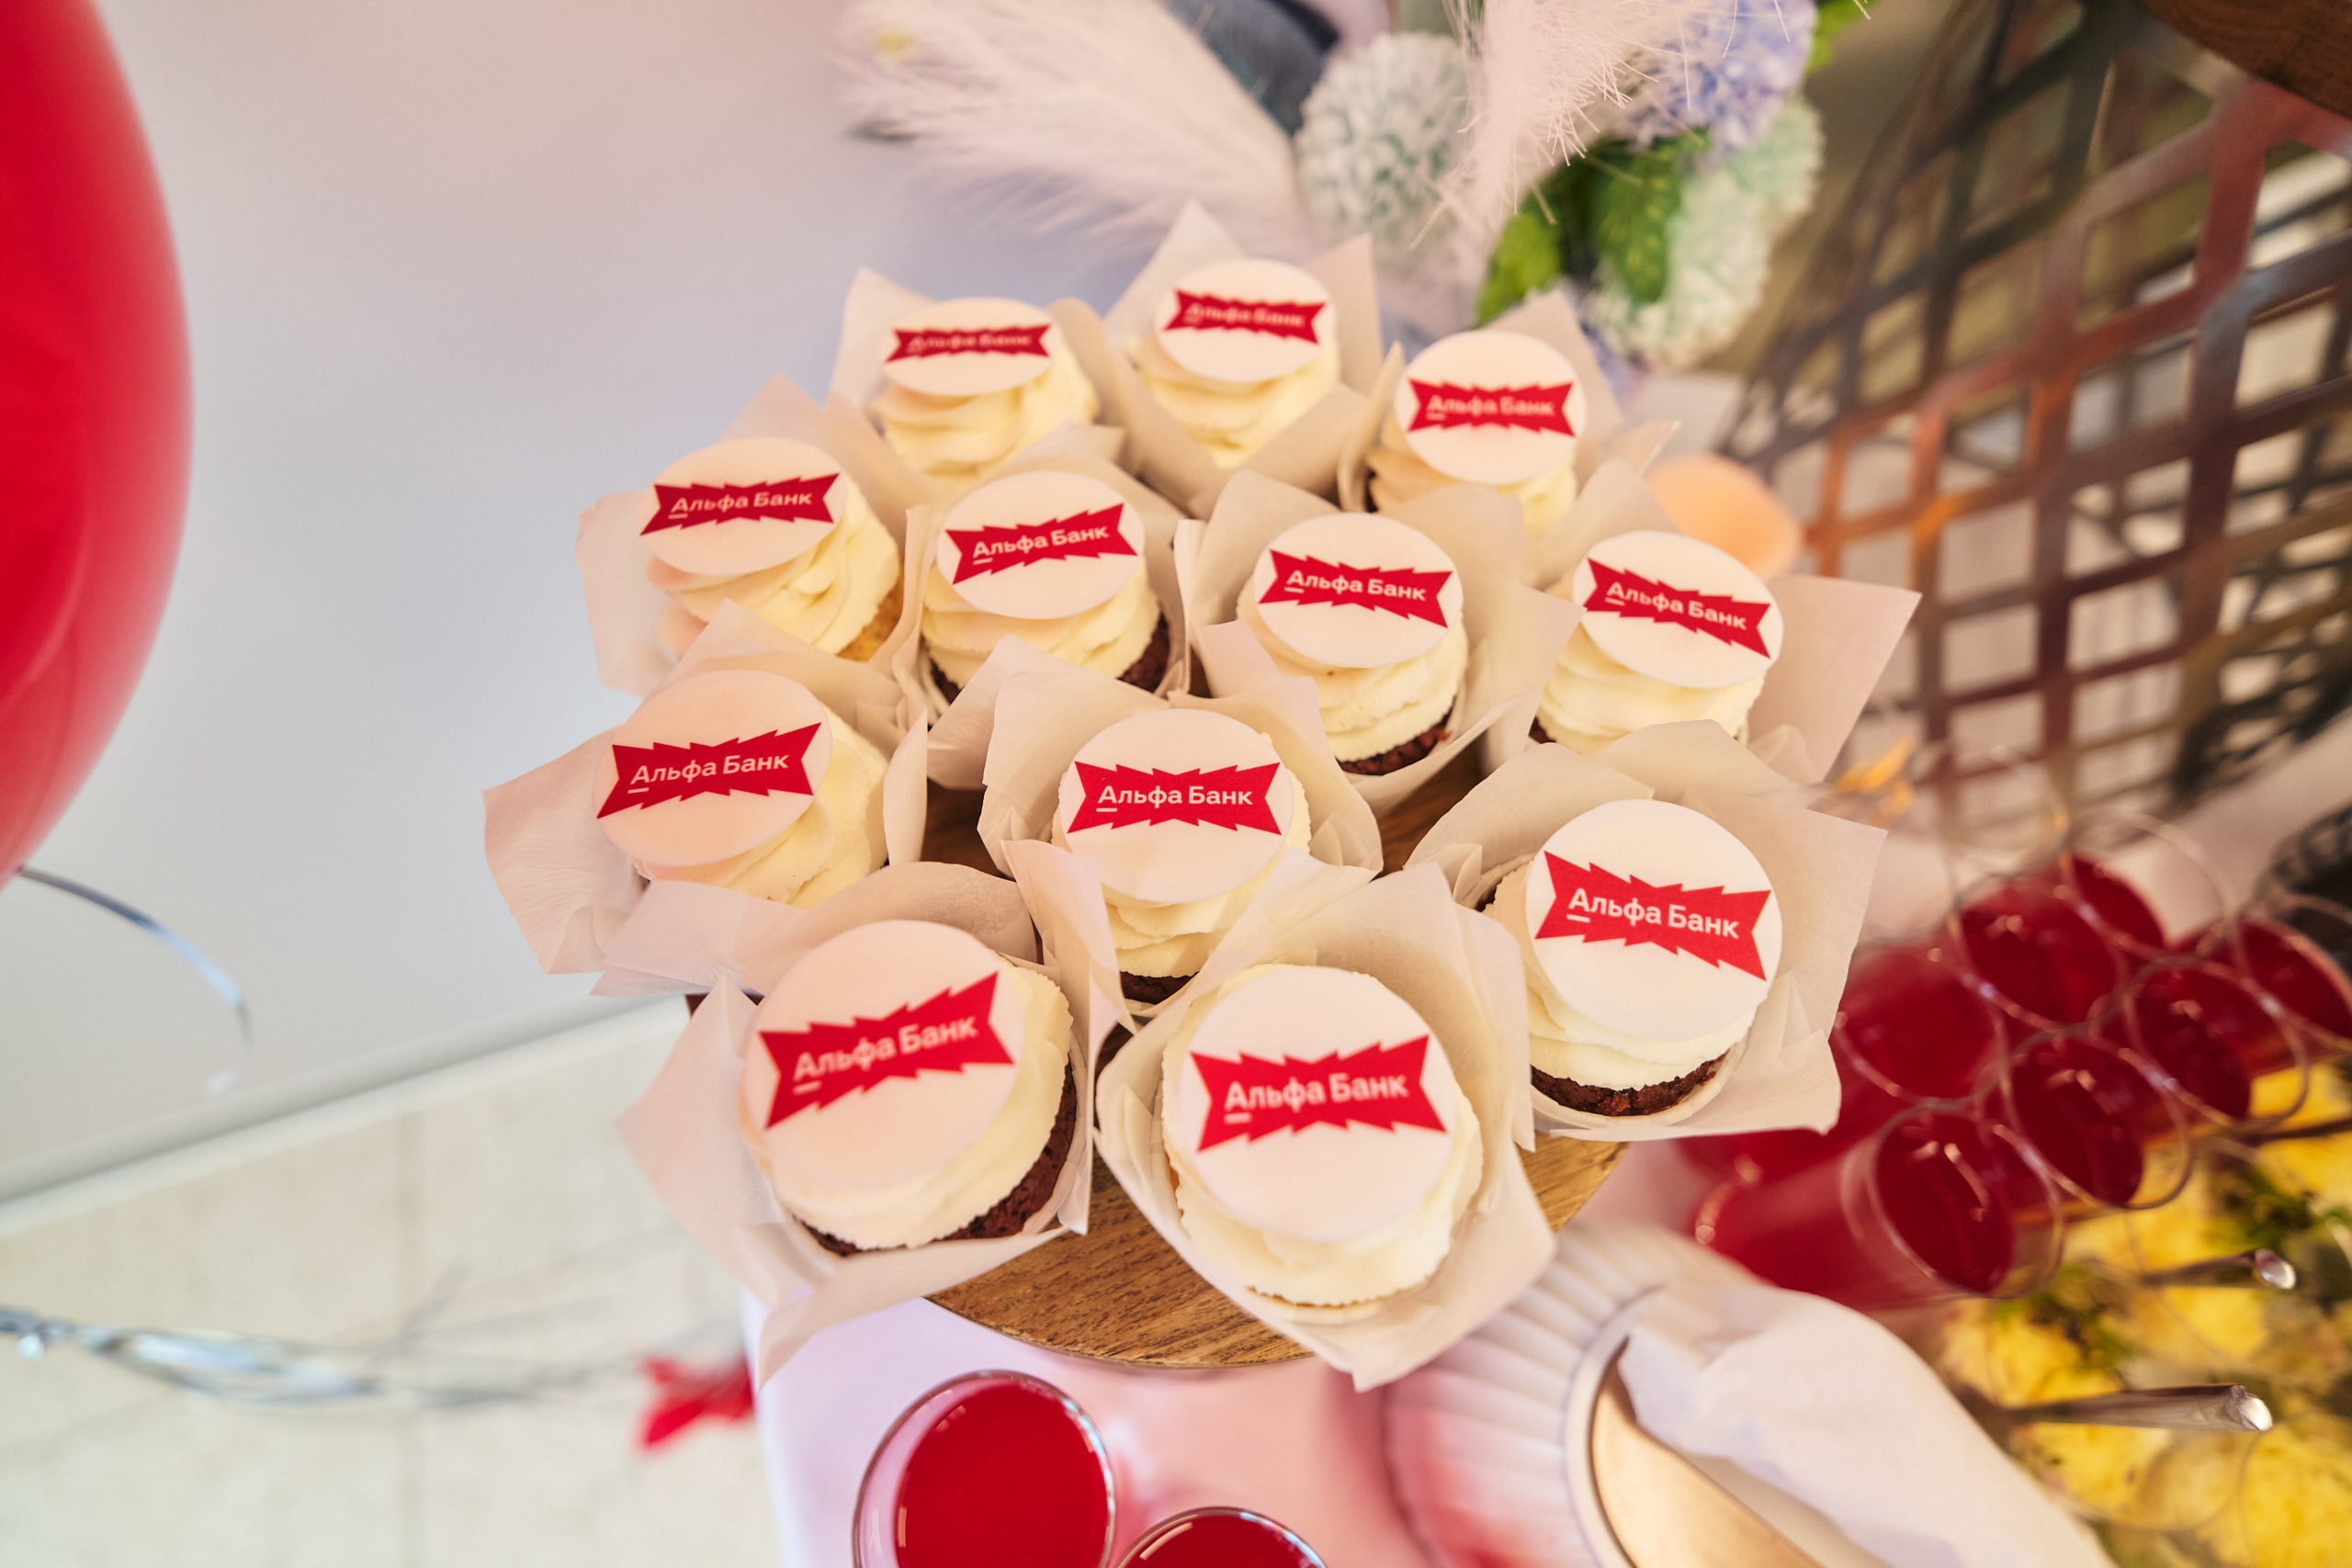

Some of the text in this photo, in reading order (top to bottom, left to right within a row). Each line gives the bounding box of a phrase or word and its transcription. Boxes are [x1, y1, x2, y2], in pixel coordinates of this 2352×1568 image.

[1427, 395, 1555, 421] Альфа Банк
[668, 491, 812, 520] Альфа Банк
[972, 526, 1109, 566] Альфа Банк
[1283, 570, 1426, 602] Альфа Банк
[1605, 581, 1747, 630] Альфа Банк
[627, 753, 789, 795] Альфа Банк
[1095, 784, 1253, 813] Альфа Банк
[1566, 887, 1739, 940] Альфа Банк
[793, 1016, 978, 1094] Альфа Банк
[1224, 1072, 1408, 1124] Альфа Банк
